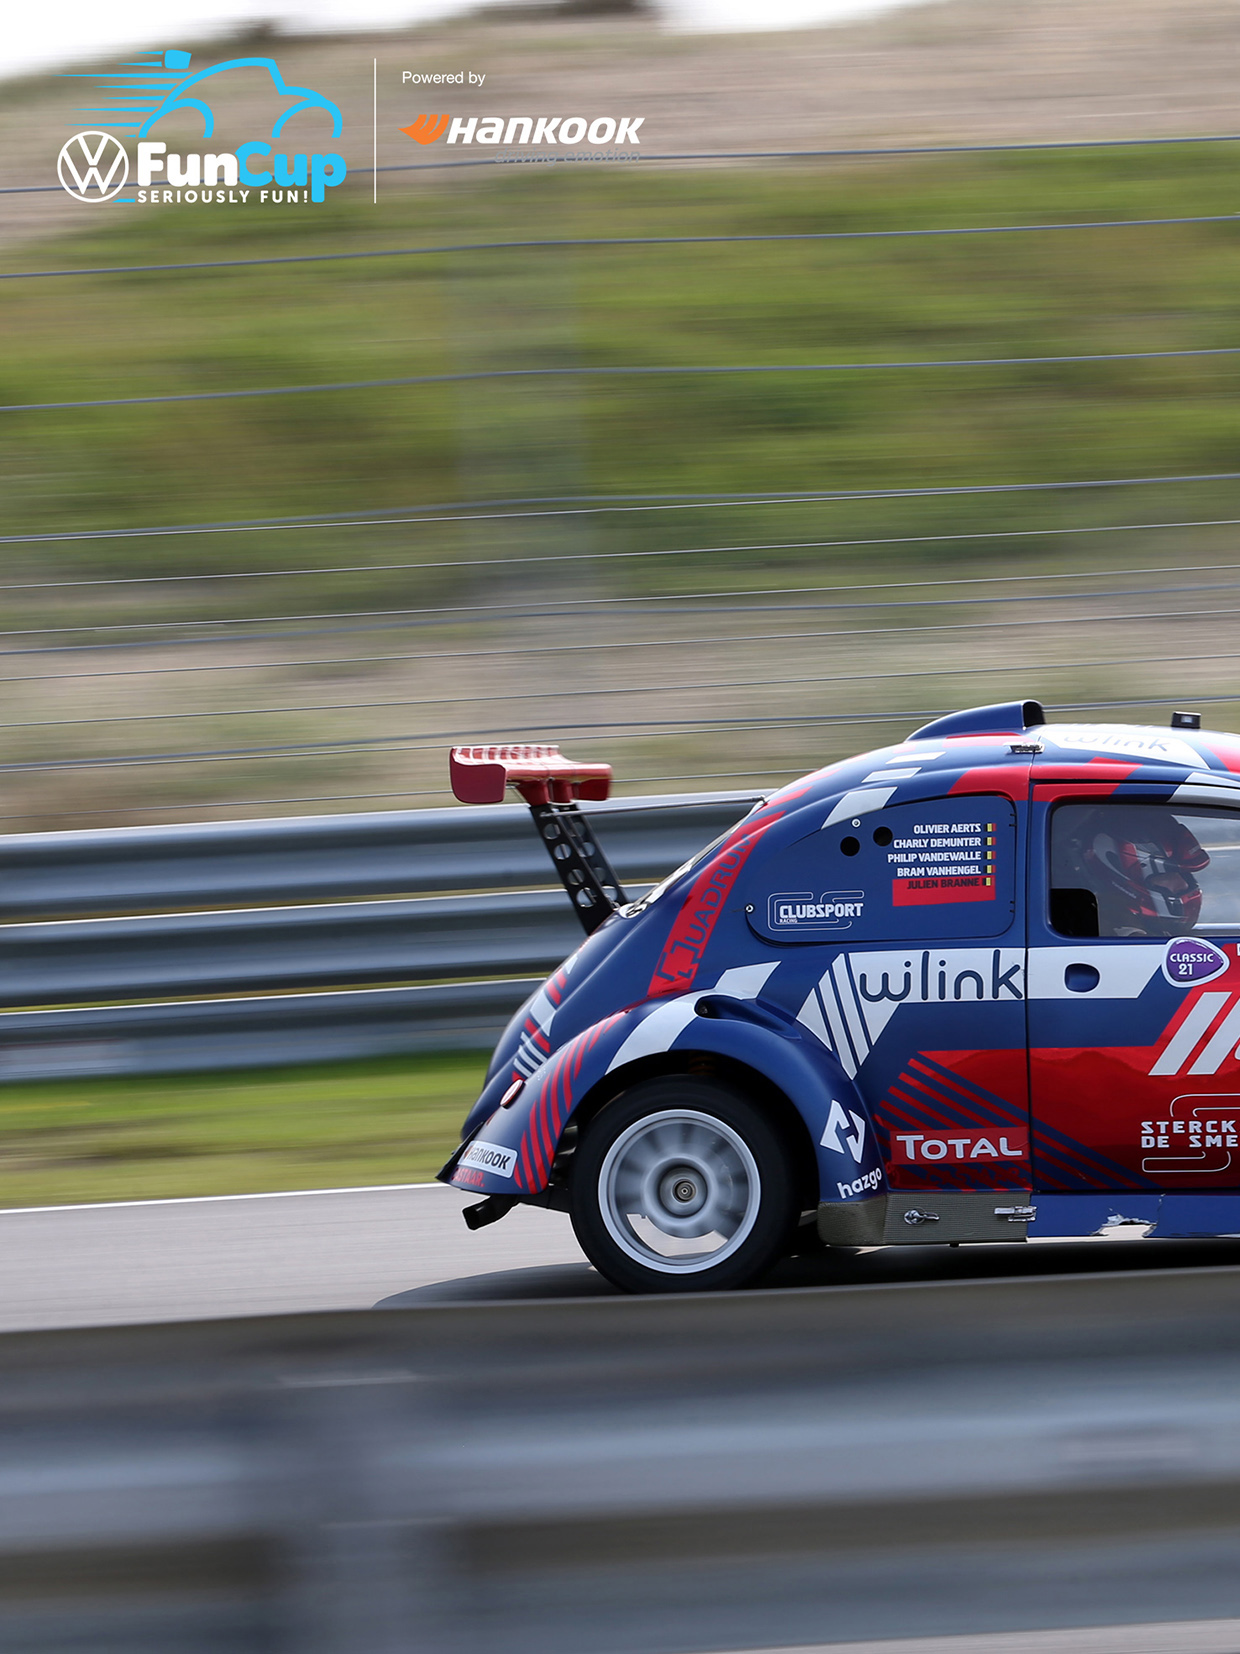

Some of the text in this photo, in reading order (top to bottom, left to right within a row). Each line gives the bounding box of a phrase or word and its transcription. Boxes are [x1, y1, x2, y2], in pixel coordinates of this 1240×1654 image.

[913, 824, 981, 834] OLIVIER AERTS
[893, 837, 981, 848] CHARLY DEMUNTER
[888, 851, 981, 863] PHILIP VANDEWALLE
[897, 865, 981, 877] BRAM VANHENGEL
[907, 878, 980, 889] JULIEN BRANNE
[780, 903, 863, 918] CLUBSPORT
[1169, 952, 1214, 963] CLASSIC
[1178, 963, 1194, 976] 21
[896, 1135, 1023, 1160] TOTAL
[1141, 1135, 1170, 1148] DE
[837, 1168, 882, 1199] hazgo
